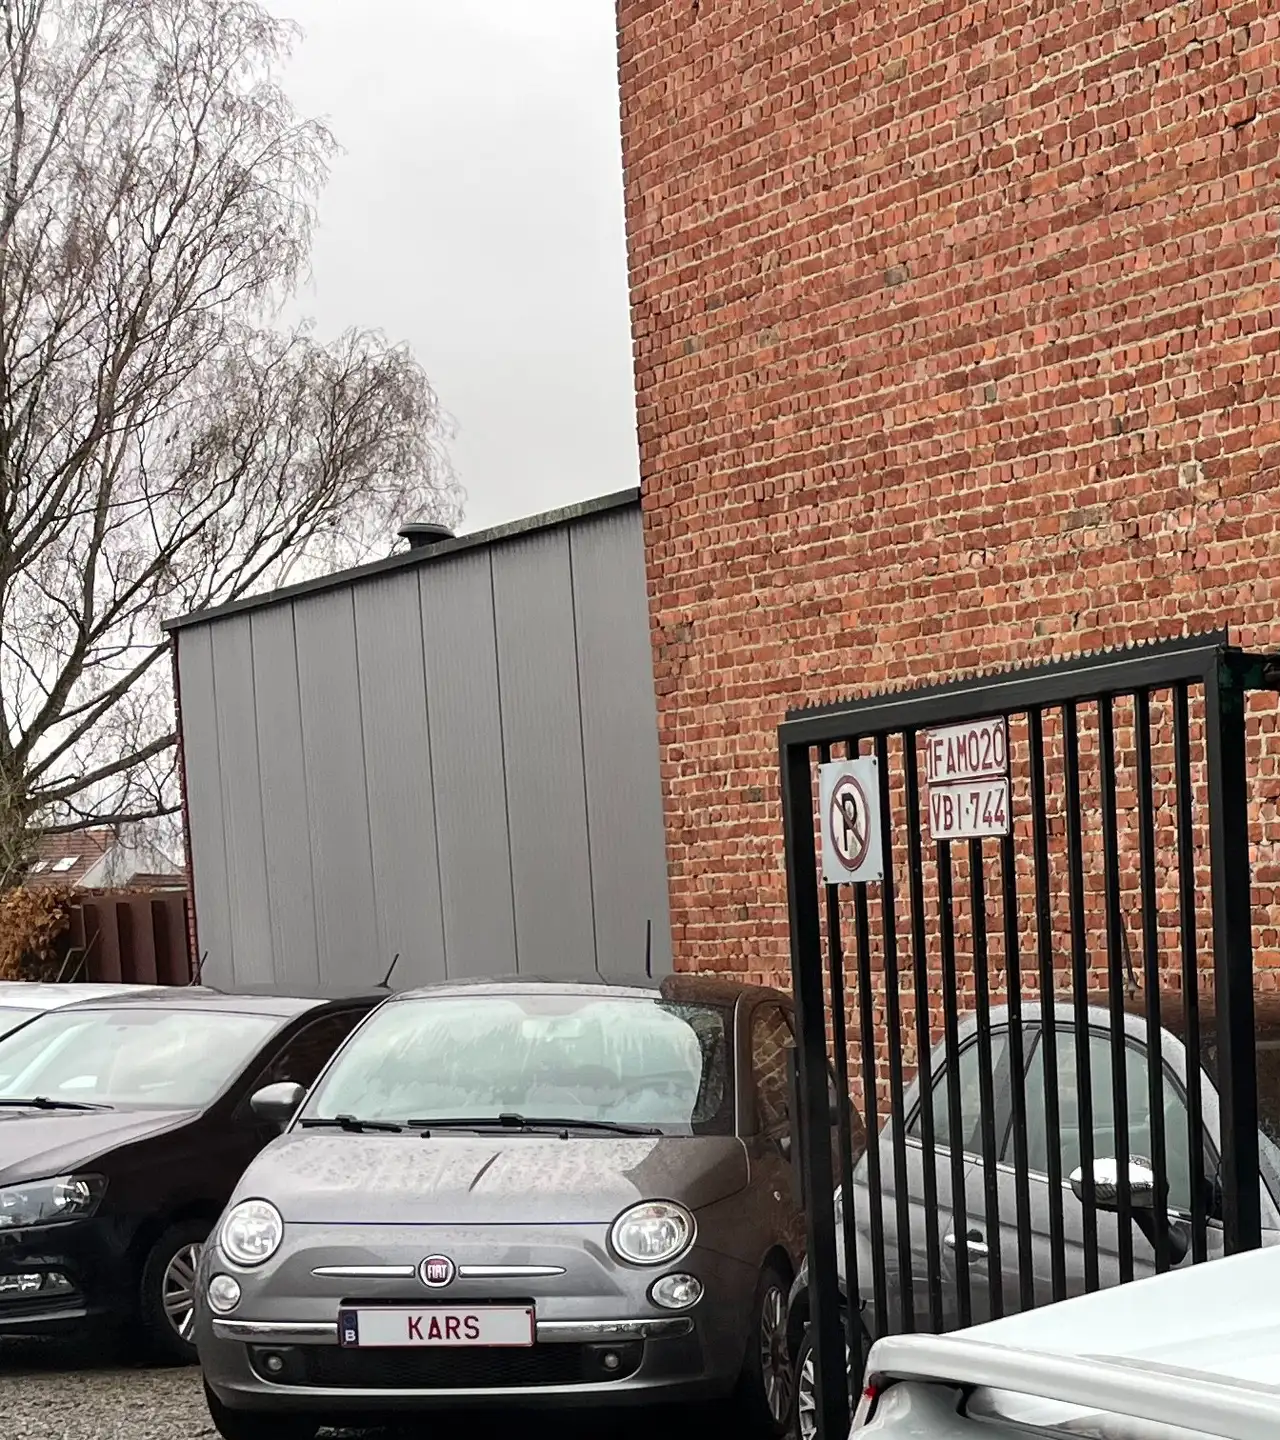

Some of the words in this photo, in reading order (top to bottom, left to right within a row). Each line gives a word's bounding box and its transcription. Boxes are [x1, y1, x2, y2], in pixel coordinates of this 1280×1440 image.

[427, 1264, 447, 1279] FIAT
[345, 1330, 356, 1341] B
[408, 1316, 480, 1340] KARS
